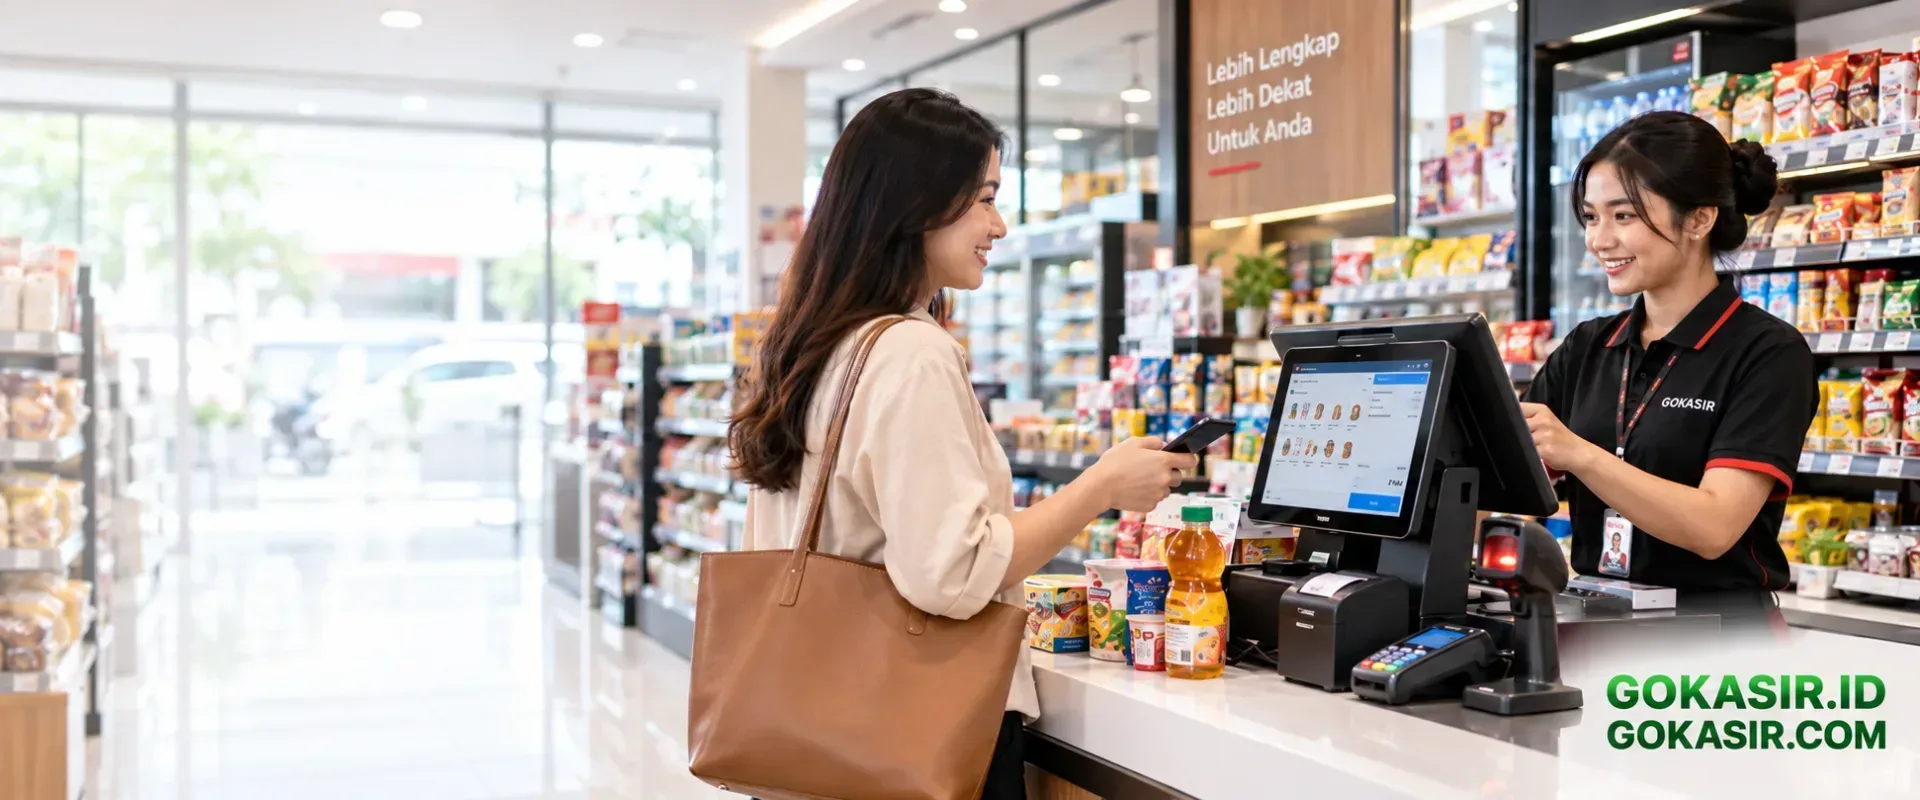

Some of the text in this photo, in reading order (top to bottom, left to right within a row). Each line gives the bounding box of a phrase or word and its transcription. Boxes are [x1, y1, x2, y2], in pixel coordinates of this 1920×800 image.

[1207, 31, 1340, 85] Lebih Lengkap
[1207, 73, 1312, 120] Lebih Dekat
[1207, 112, 1312, 155] Untuk Anda
[1661, 396, 1716, 412] GOKASIR
